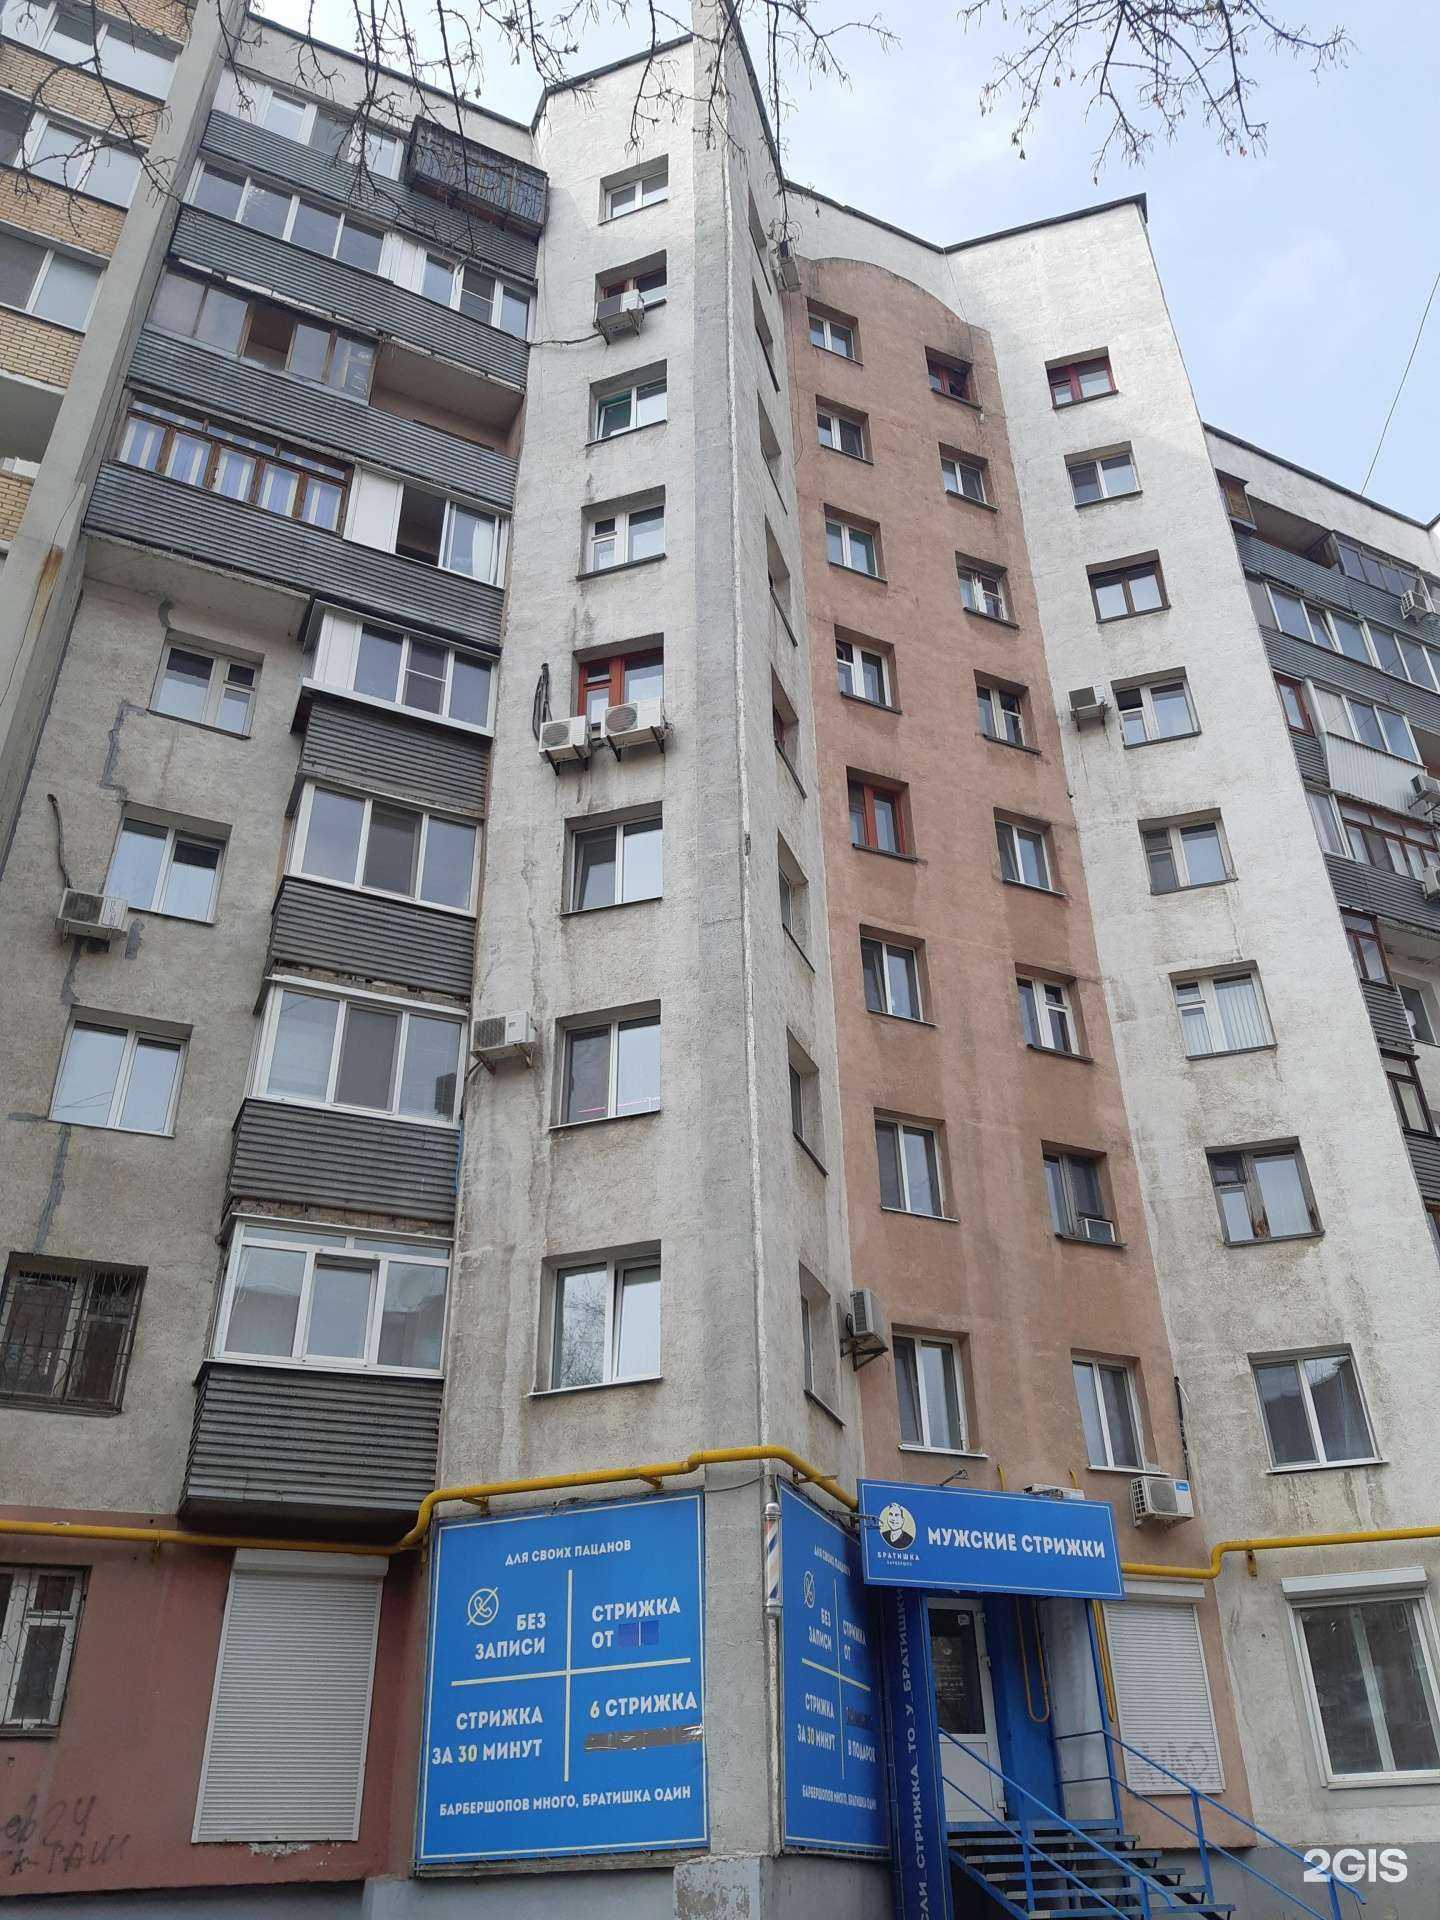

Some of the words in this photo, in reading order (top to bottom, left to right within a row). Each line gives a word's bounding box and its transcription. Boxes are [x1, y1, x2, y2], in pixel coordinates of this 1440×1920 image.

[505, 1553, 529, 1567] ДЛЯ
[531, 1546, 572, 1562] СВОИХ
[574, 1540, 632, 1557] ПАЦАНОВ
[927, 1527, 1017, 1552] МУЖСКИЕ
[1021, 1534, 1106, 1559] СТРИЖКИ
[877, 1551, 920, 1561] БРАТИШКА
[516, 1612, 547, 1632] БЕЗ
[591, 1597, 681, 1622] СТРИЖКА
[474, 1637, 546, 1661] ЗАПИСИ
[591, 1630, 615, 1649] ОТ
[589, 1700, 600, 1719] 6
[605, 1691, 698, 1717] СТРИЖКА
[804, 1692, 835, 1720] СТРИЖКА
[456, 1706, 543, 1730] СТРИЖКА
[797, 1723, 807, 1744] ЗА
[431, 1746, 453, 1765] ЗА
[458, 1744, 478, 1763] 30
[482, 1738, 543, 1761] МИНУТ
[439, 1798, 530, 1816] БАРБЕРШОПОВ
[582, 1789, 652, 1807] БРАТИШКА
[654, 1785, 691, 1802] ОДИН
